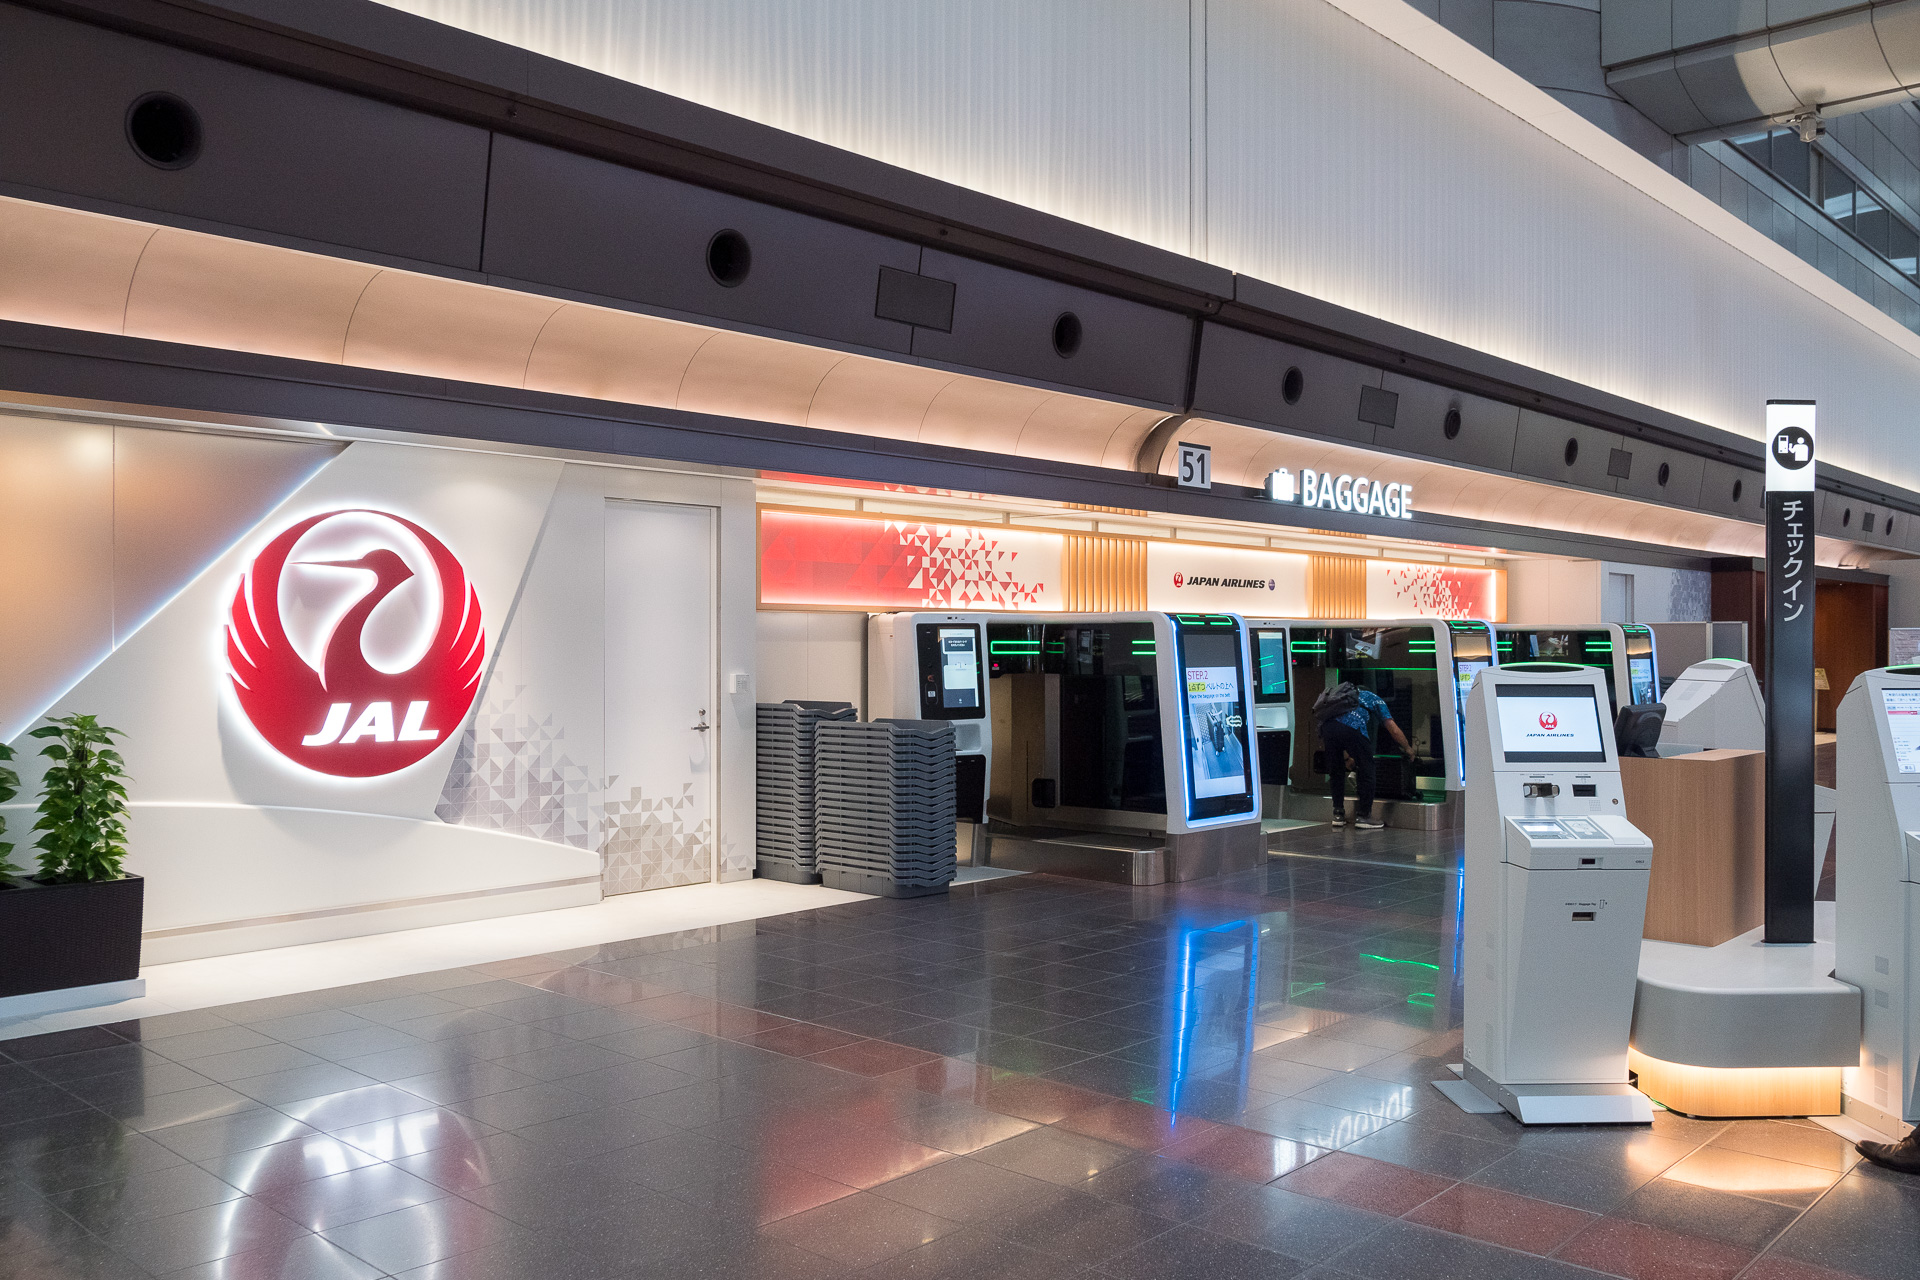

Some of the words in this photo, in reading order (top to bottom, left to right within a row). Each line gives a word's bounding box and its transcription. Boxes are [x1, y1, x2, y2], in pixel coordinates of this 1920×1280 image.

[1181, 450, 1207, 486] 51
[1301, 468, 1413, 520] BAGGAGE
[1187, 576, 1219, 587] JAPAN
[1221, 578, 1266, 589] AIRLINES
[1782, 499, 1805, 623] チェックイン
[301, 700, 440, 747] JAL
